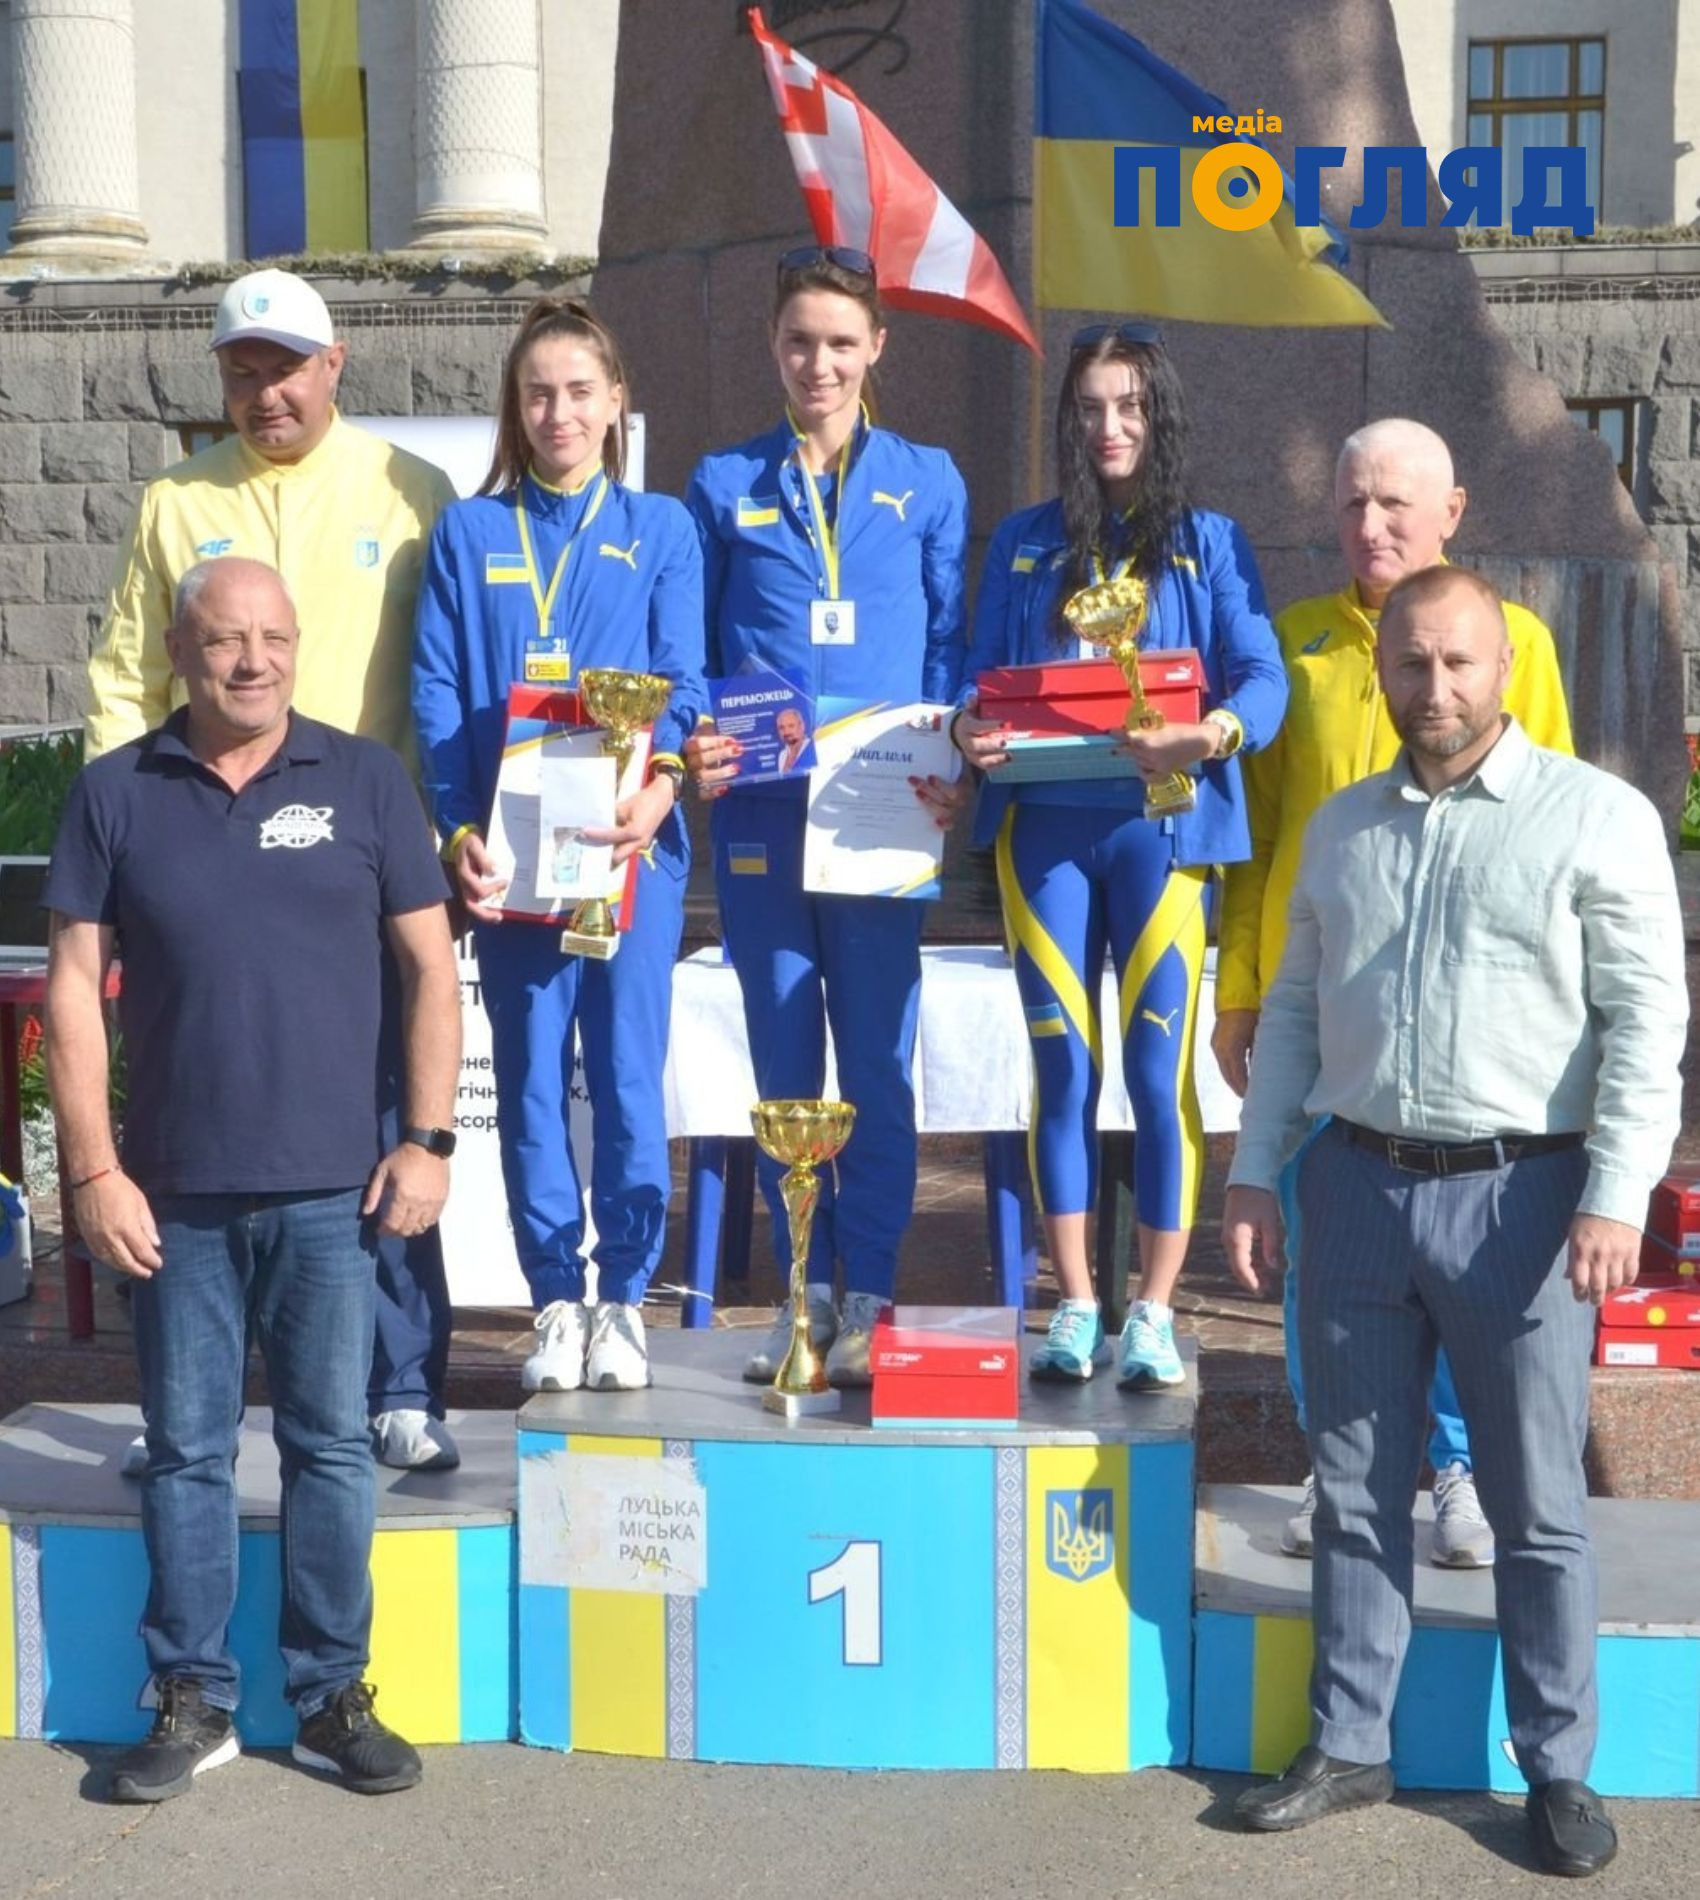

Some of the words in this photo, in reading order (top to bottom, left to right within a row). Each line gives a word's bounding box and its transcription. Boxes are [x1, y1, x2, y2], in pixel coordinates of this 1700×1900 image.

[720, 689, 795, 709] ПЕРЕМОЖЕЦЬ
[618, 1495, 701, 1520] ЛУЦЬКА
[619, 1520, 696, 1541] МІСЬКА
[619, 1543, 673, 1566] РАДА
[807, 1540, 883, 1667] 1
